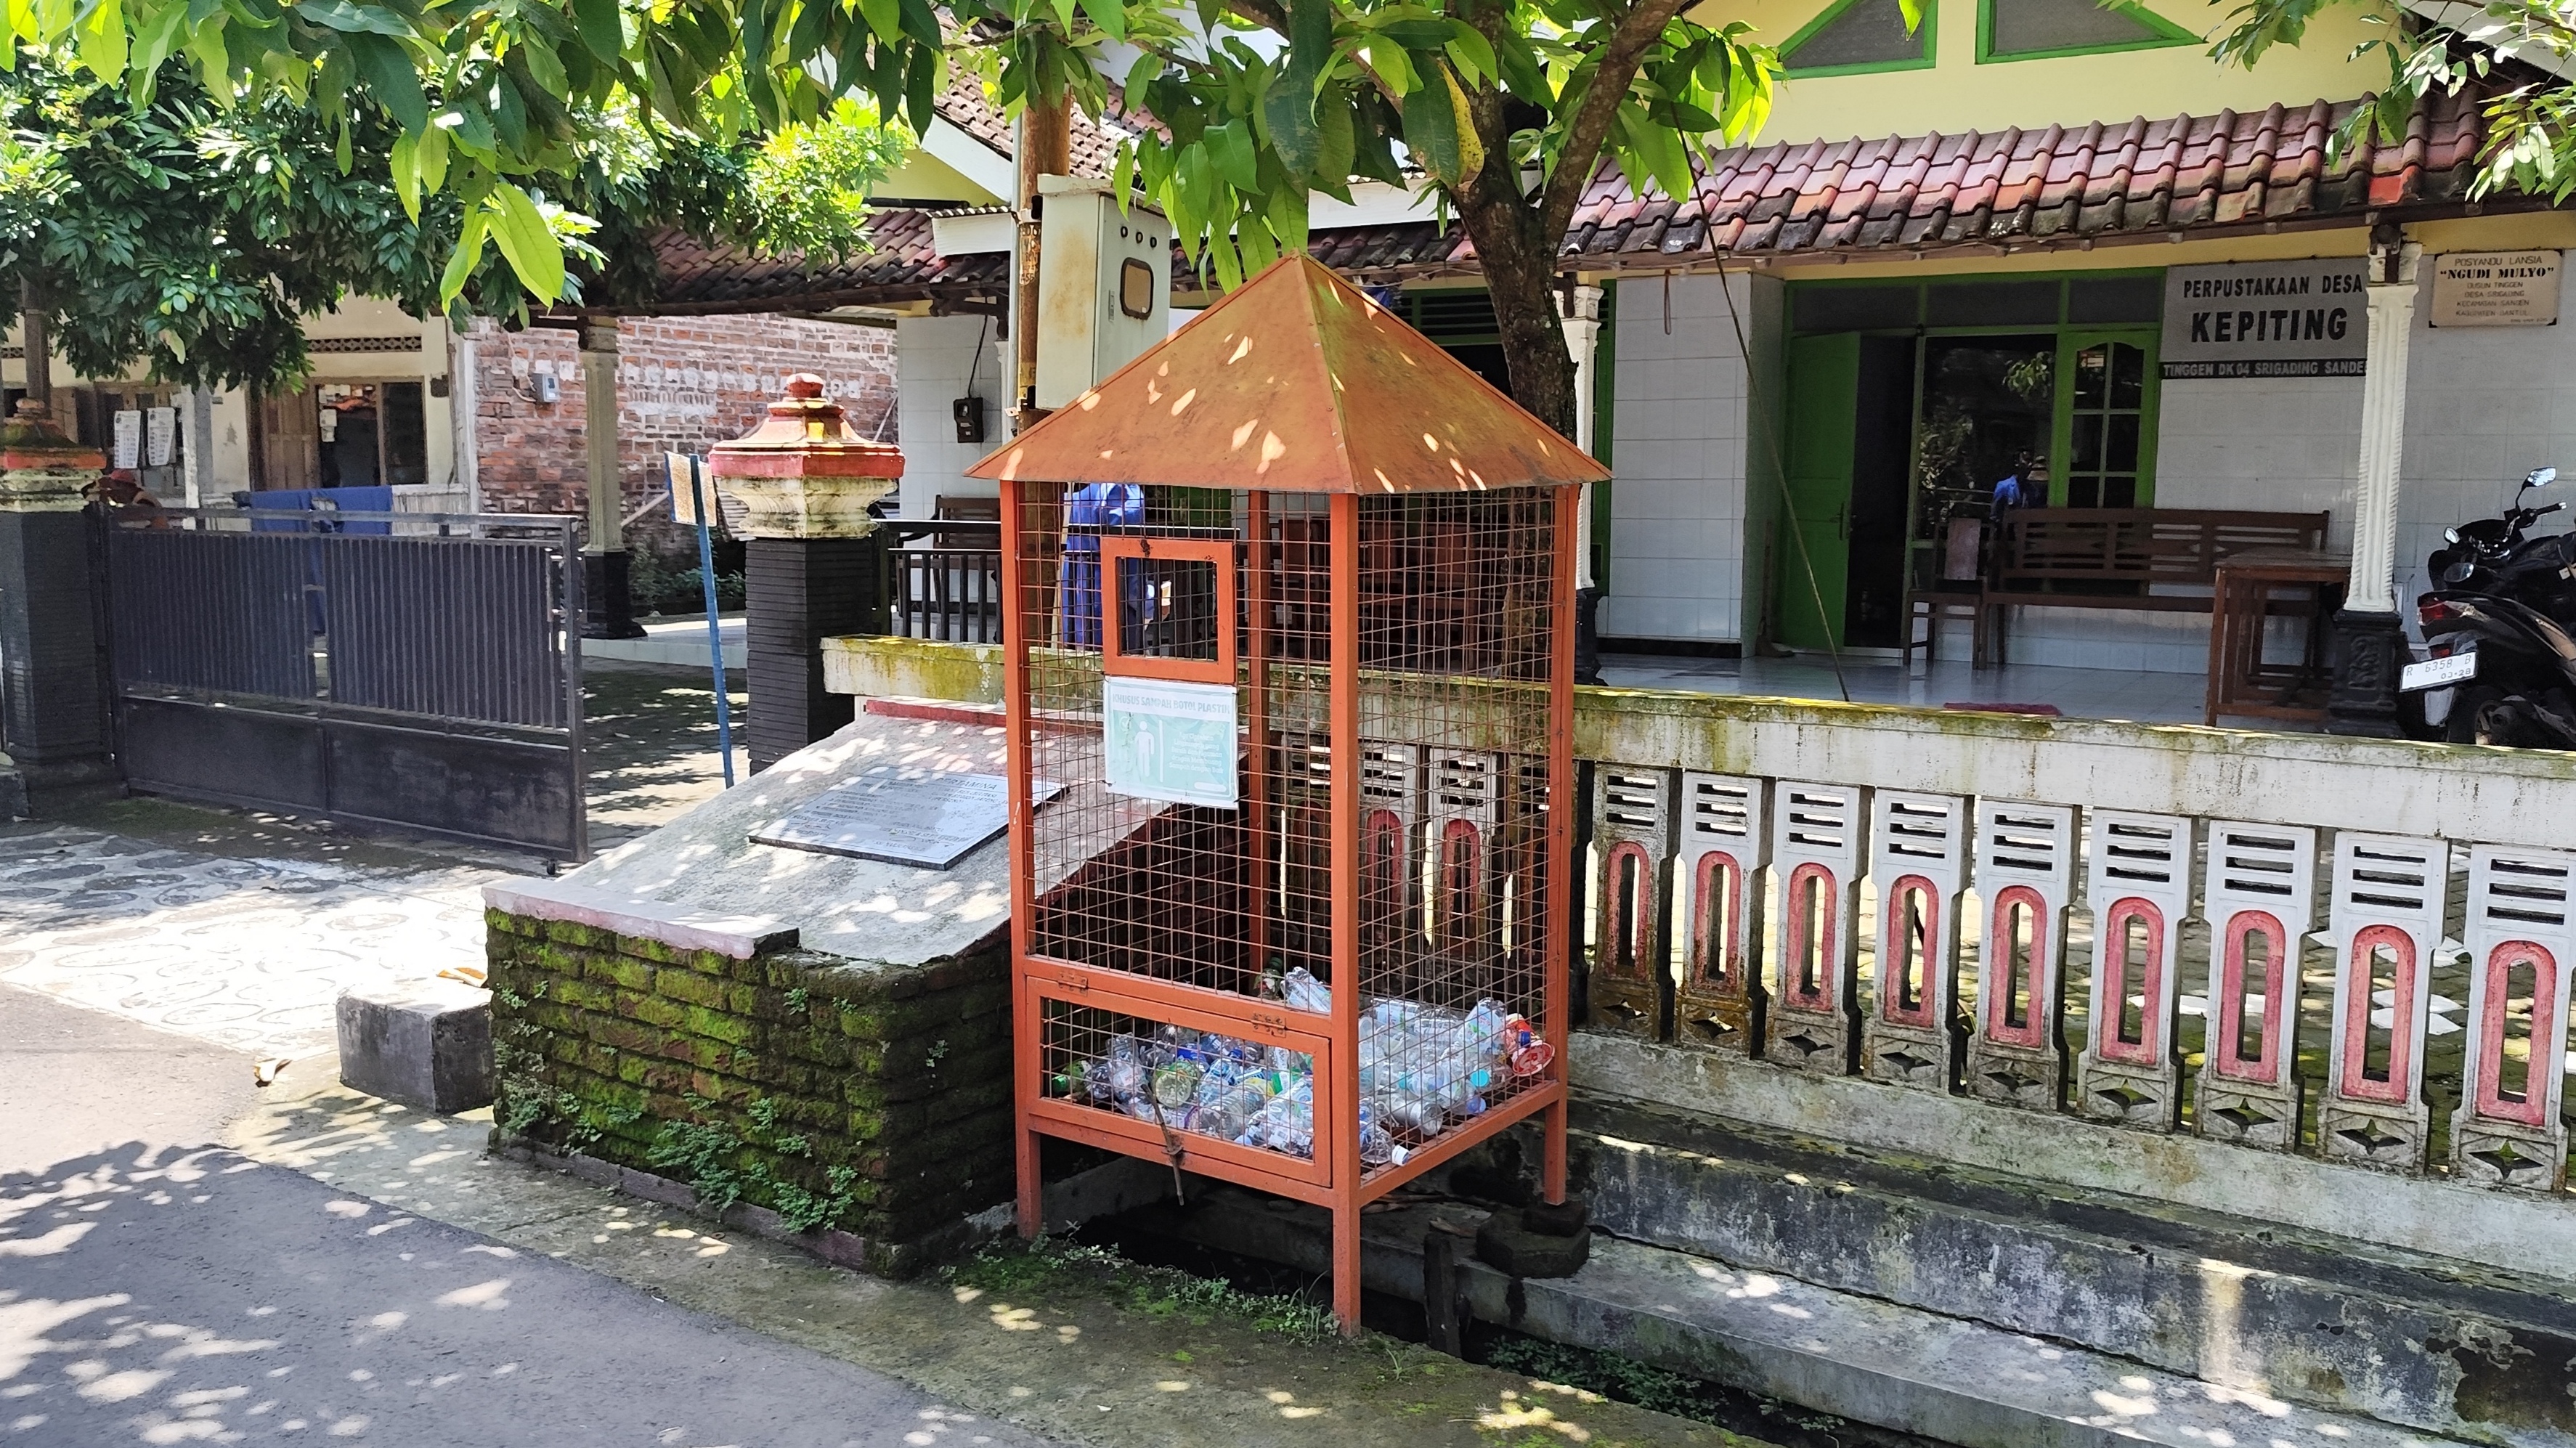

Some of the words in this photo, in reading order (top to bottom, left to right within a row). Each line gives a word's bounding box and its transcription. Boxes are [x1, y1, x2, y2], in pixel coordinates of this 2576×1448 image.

[2455, 257, 2503, 266] POSYANDU
[2509, 256, 2543, 265] LANSIA
[2183, 276, 2310, 298] PERPUSTAKAAN
[2322, 274, 2363, 294] DESA
[2191, 307, 2347, 343] KEPITING
[2163, 362, 2214, 377] TINGGEN
[2254, 362, 2318, 376] SRIGADING
[2324, 360, 2367, 375] SANDE
[2406, 666, 2413, 677] R
[1113, 694, 1140, 705] KHUSUS
[1141, 696, 1172, 709] SAMPAH
[1173, 700, 1197, 712] BOTOL
[1198, 702, 1230, 714] PLASTIK
